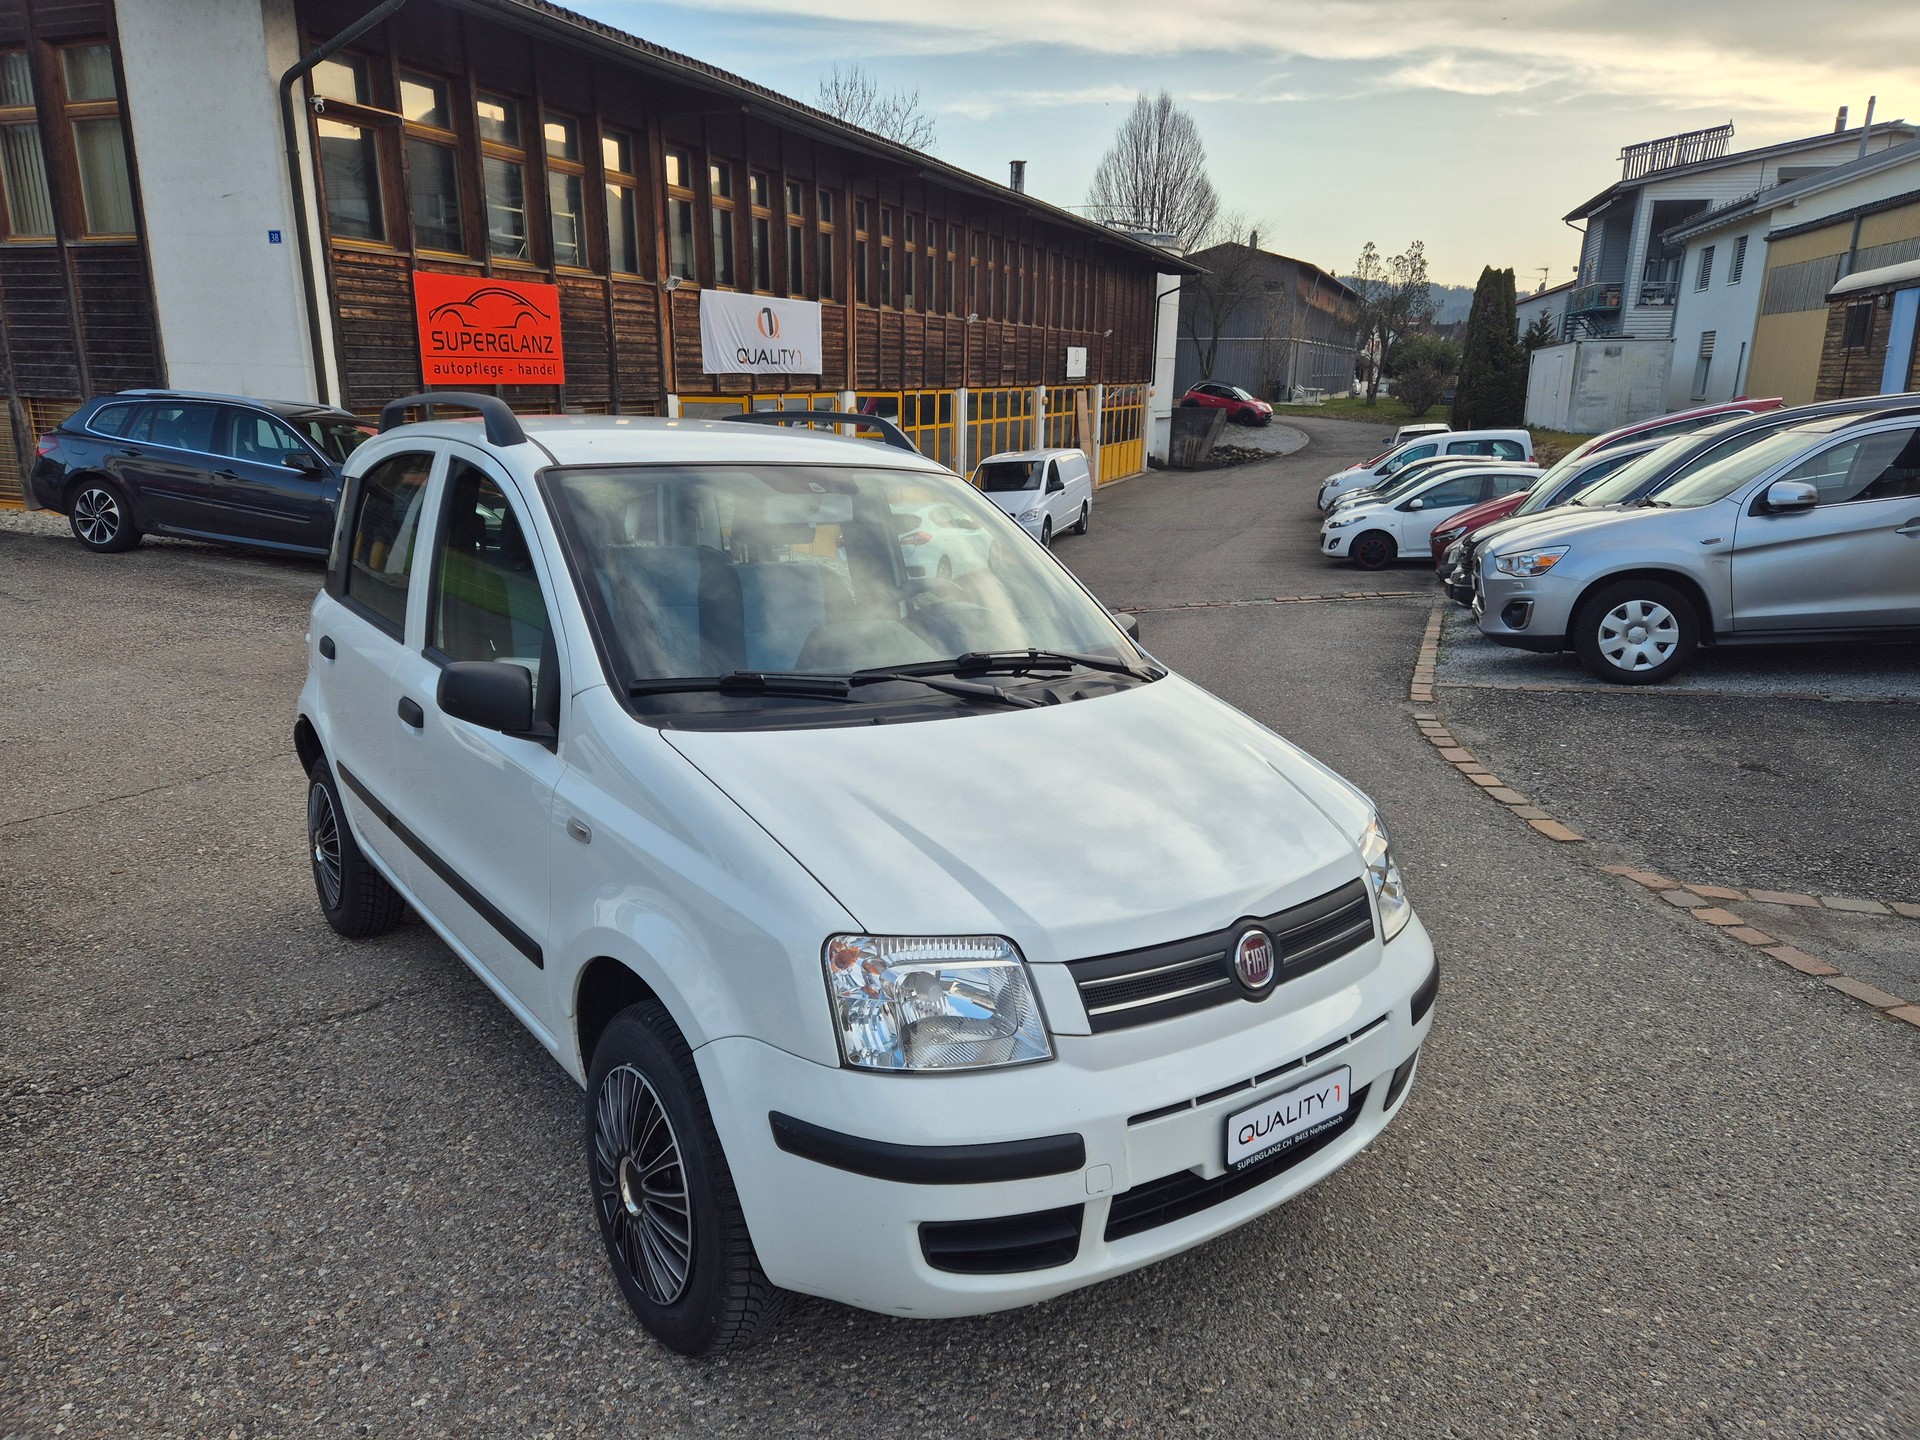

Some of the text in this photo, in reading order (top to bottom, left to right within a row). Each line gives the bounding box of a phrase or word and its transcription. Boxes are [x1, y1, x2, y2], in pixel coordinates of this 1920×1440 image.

[271, 232, 280, 242] 38
[431, 330, 554, 354] SUPERGLANZ
[736, 347, 795, 365] QUALITY
[433, 362, 504, 377] autopflege
[518, 363, 556, 376] handel
[1244, 945, 1268, 976] FIAT
[1238, 1085, 1341, 1145] QUALITY 1
[1237, 1115, 1343, 1171] SUPERGLANZ.CH 8413 Neftenbach
